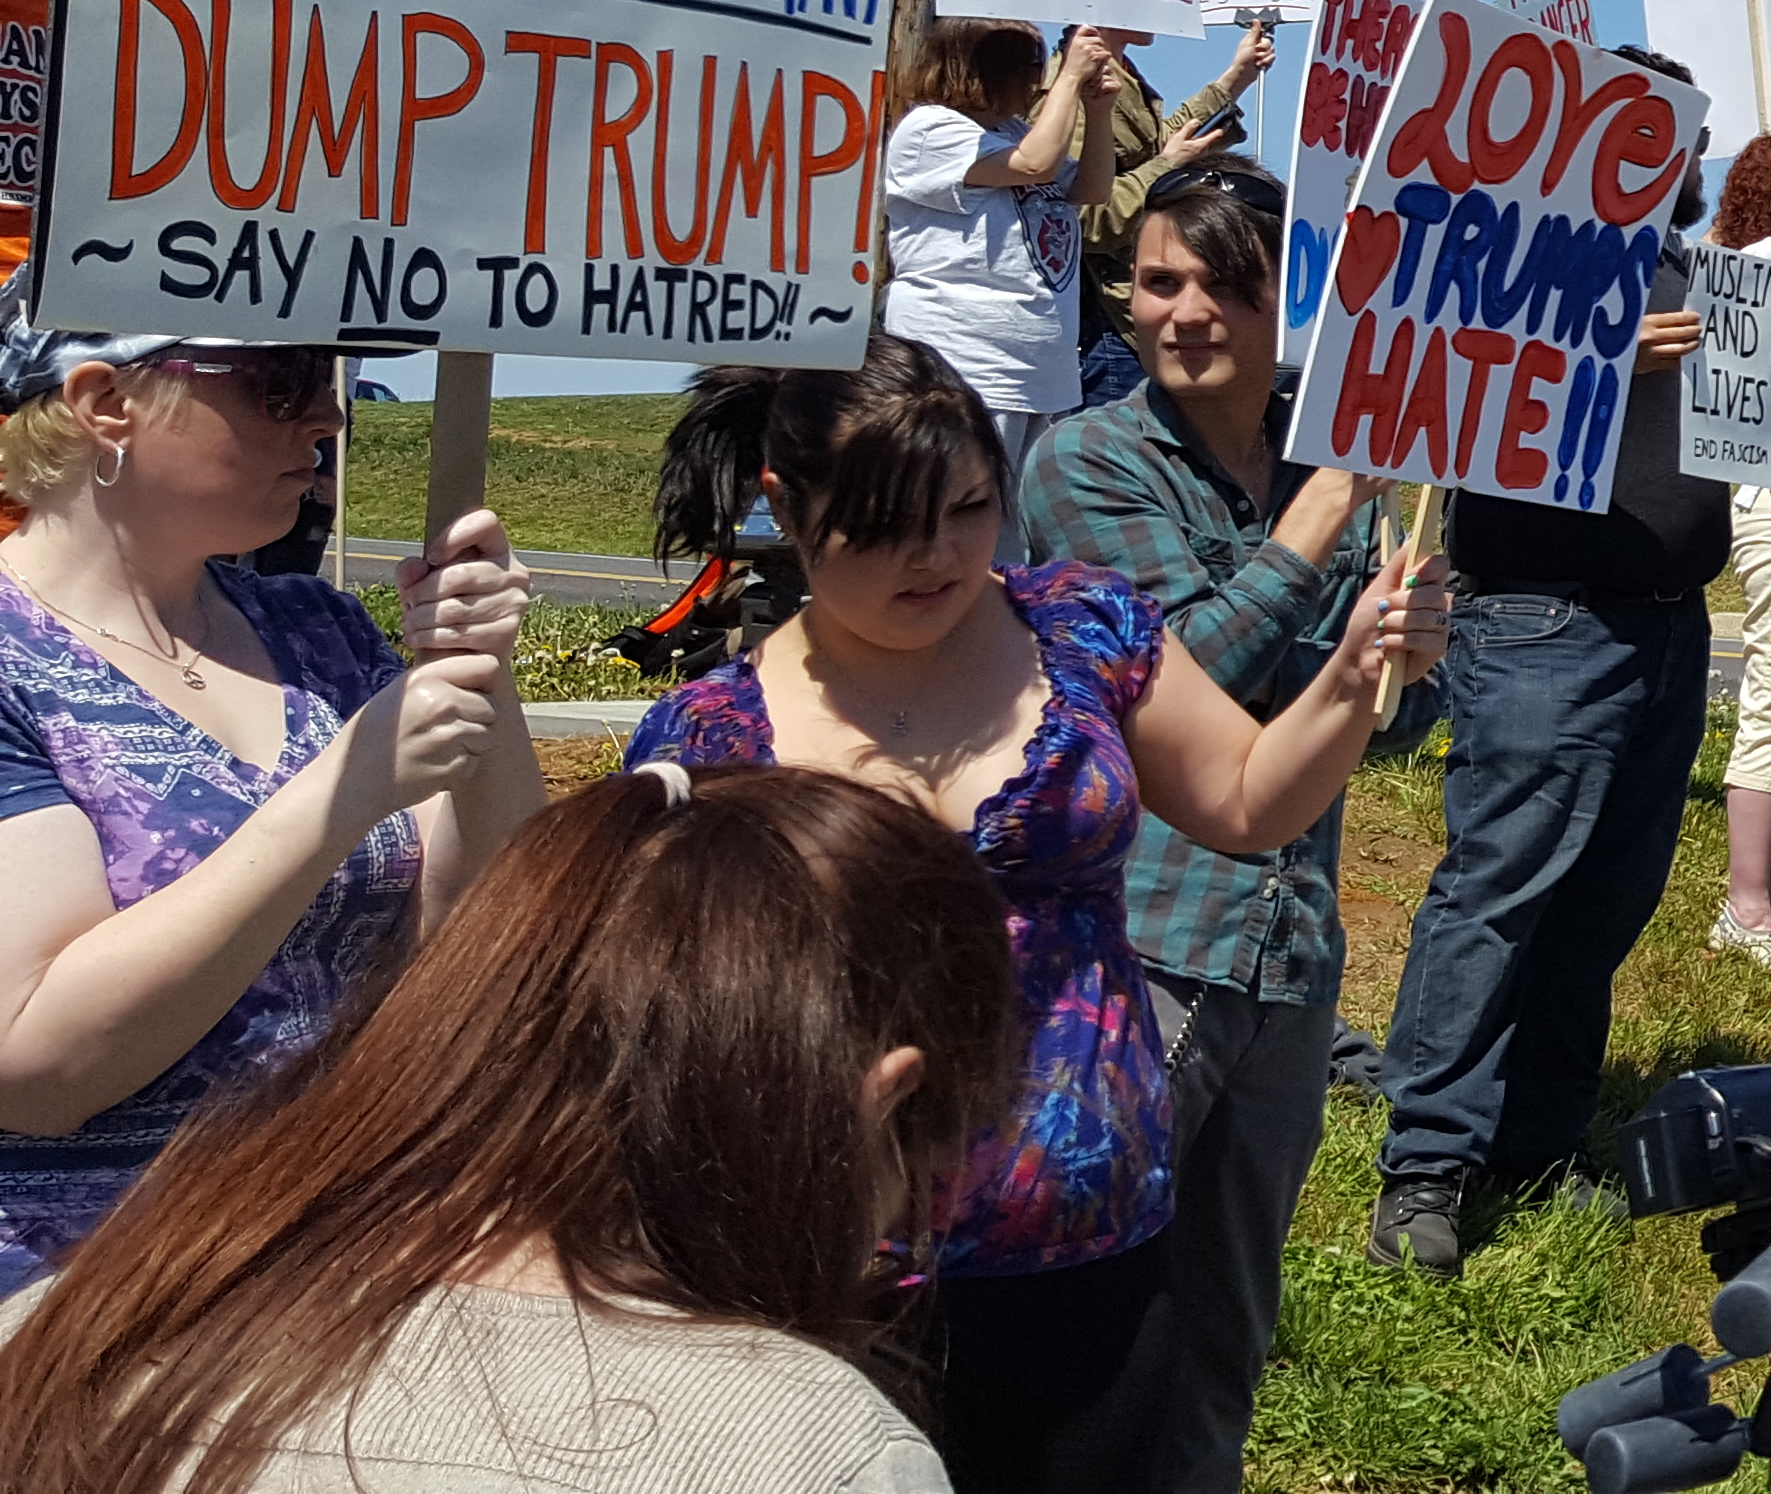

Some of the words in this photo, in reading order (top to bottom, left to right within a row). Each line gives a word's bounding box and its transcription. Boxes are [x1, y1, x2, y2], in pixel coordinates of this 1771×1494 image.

[505, 30, 888, 285] TRUMP!
[157, 219, 316, 320] SAY
[343, 236, 448, 325] NO
[477, 256, 558, 329] TO
[583, 263, 799, 346] HATRED!!
[1390, 181, 1660, 361] TRUMPS
[1702, 303, 1759, 359] AND
[1331, 309, 1619, 509] HATE!!
[1692, 362, 1769, 426] LIVES
[1694, 437, 1718, 459] END
[1721, 440, 1769, 465] FASCISM
